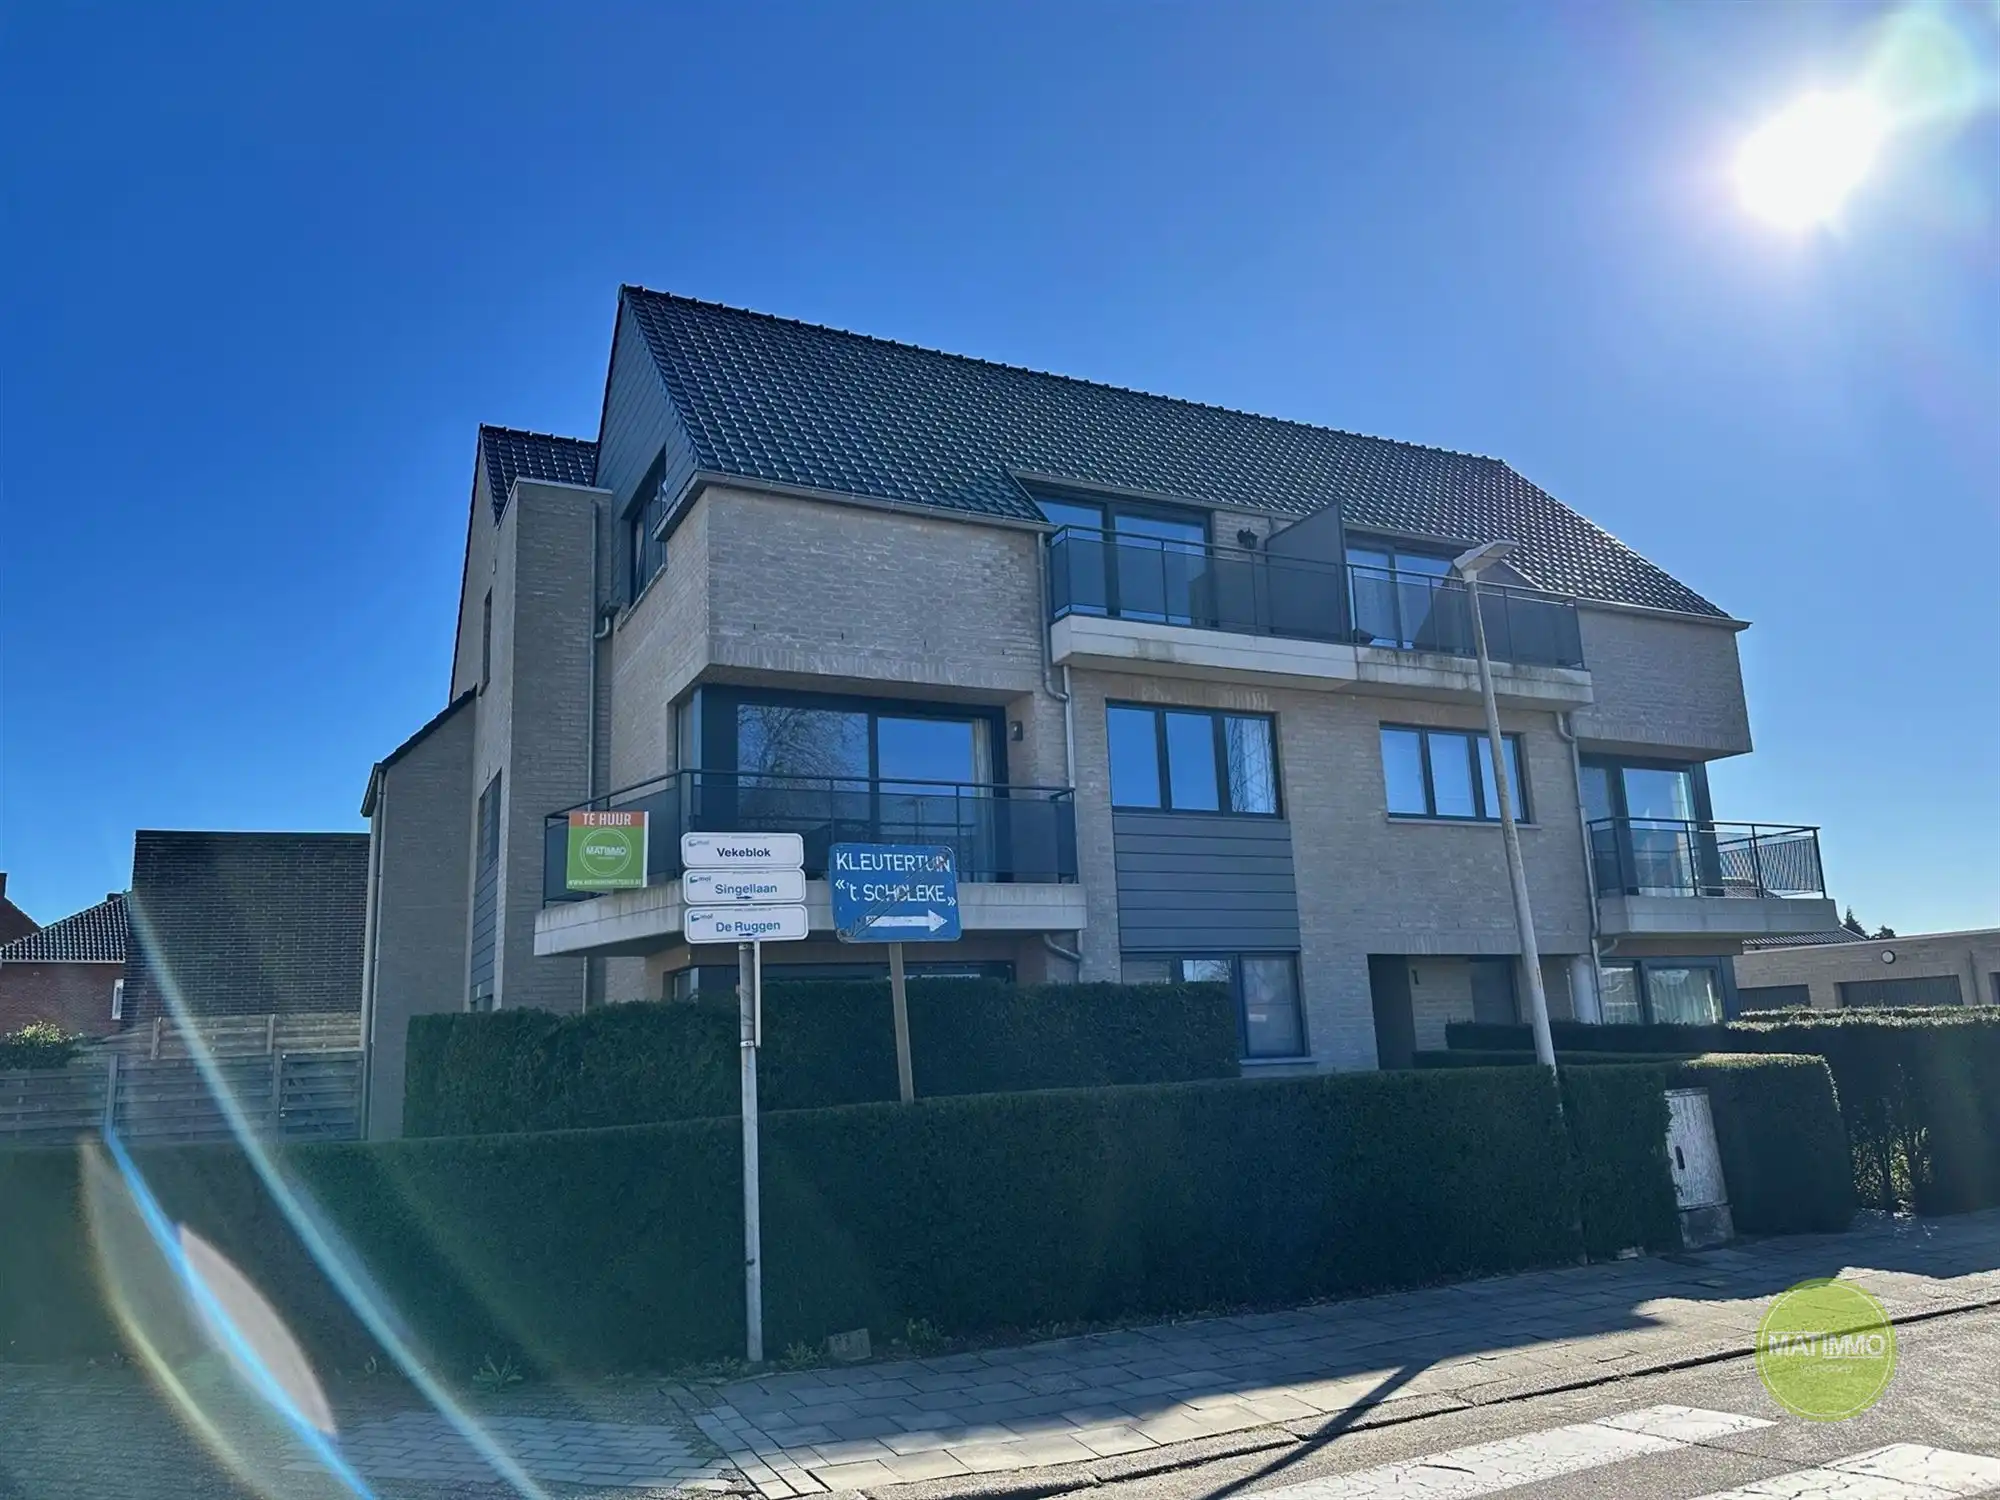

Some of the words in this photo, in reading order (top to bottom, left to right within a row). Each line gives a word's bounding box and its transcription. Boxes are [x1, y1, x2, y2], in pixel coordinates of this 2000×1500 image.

[583, 812, 596, 826] TE
[599, 812, 632, 826] HUUR
[716, 847, 771, 858] Vekeblok
[836, 851, 951, 873] KLEUTERTUIN
[715, 883, 778, 896] Singellaan
[715, 921, 732, 933] De
[734, 920, 781, 934] Ruggen
